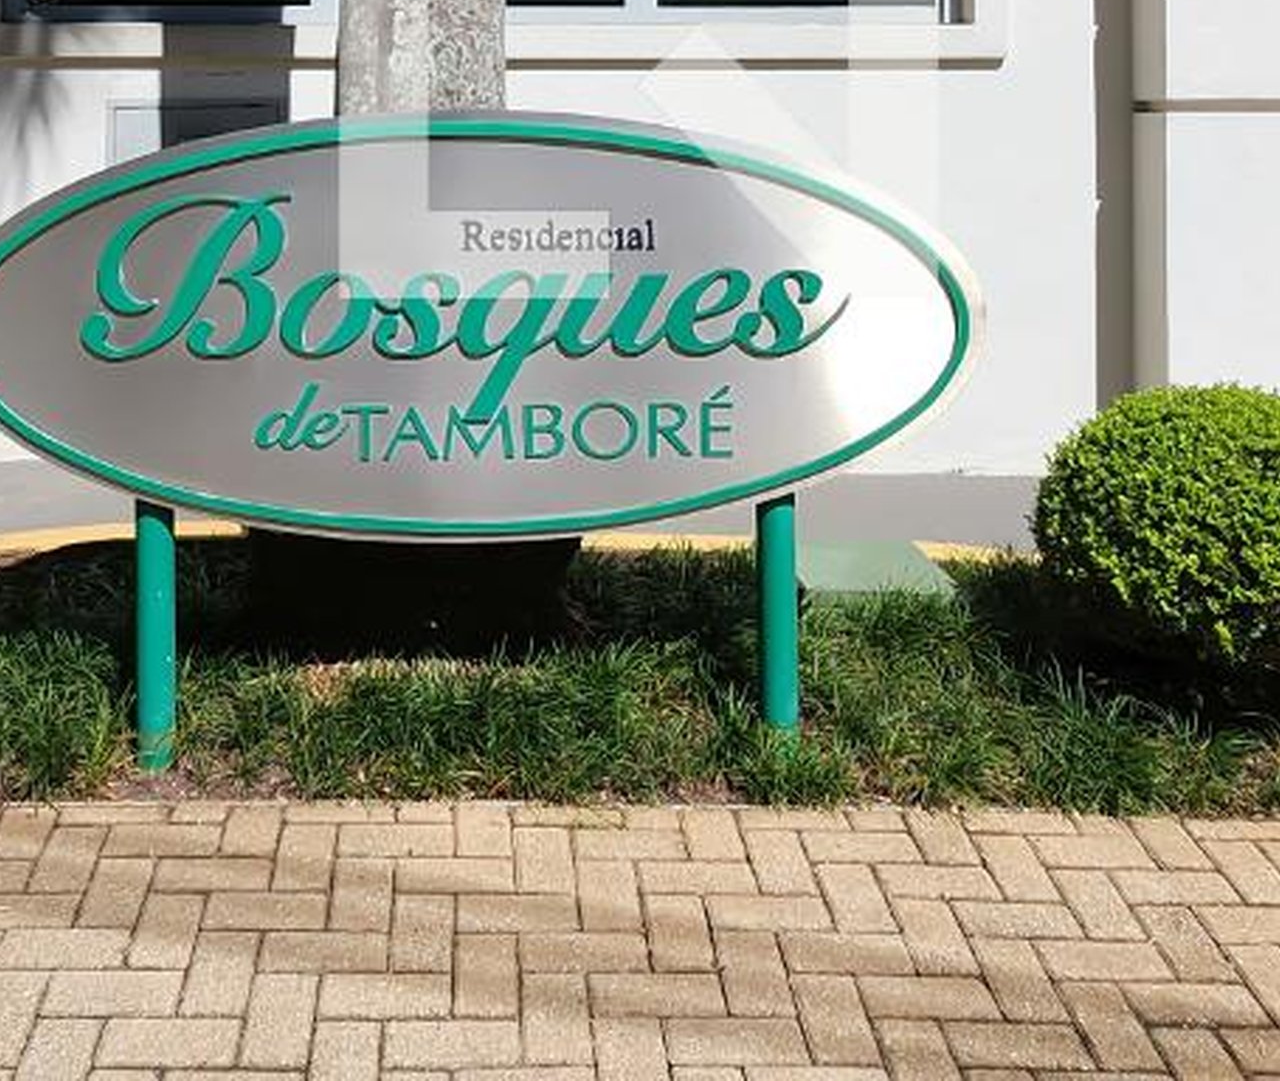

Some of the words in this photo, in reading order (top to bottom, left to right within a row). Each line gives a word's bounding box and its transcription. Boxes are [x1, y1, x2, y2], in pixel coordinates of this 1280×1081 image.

[460, 218, 655, 251] Residencial
[79, 193, 850, 425] Bosques
[340, 385, 734, 462] TAMBORÉ
